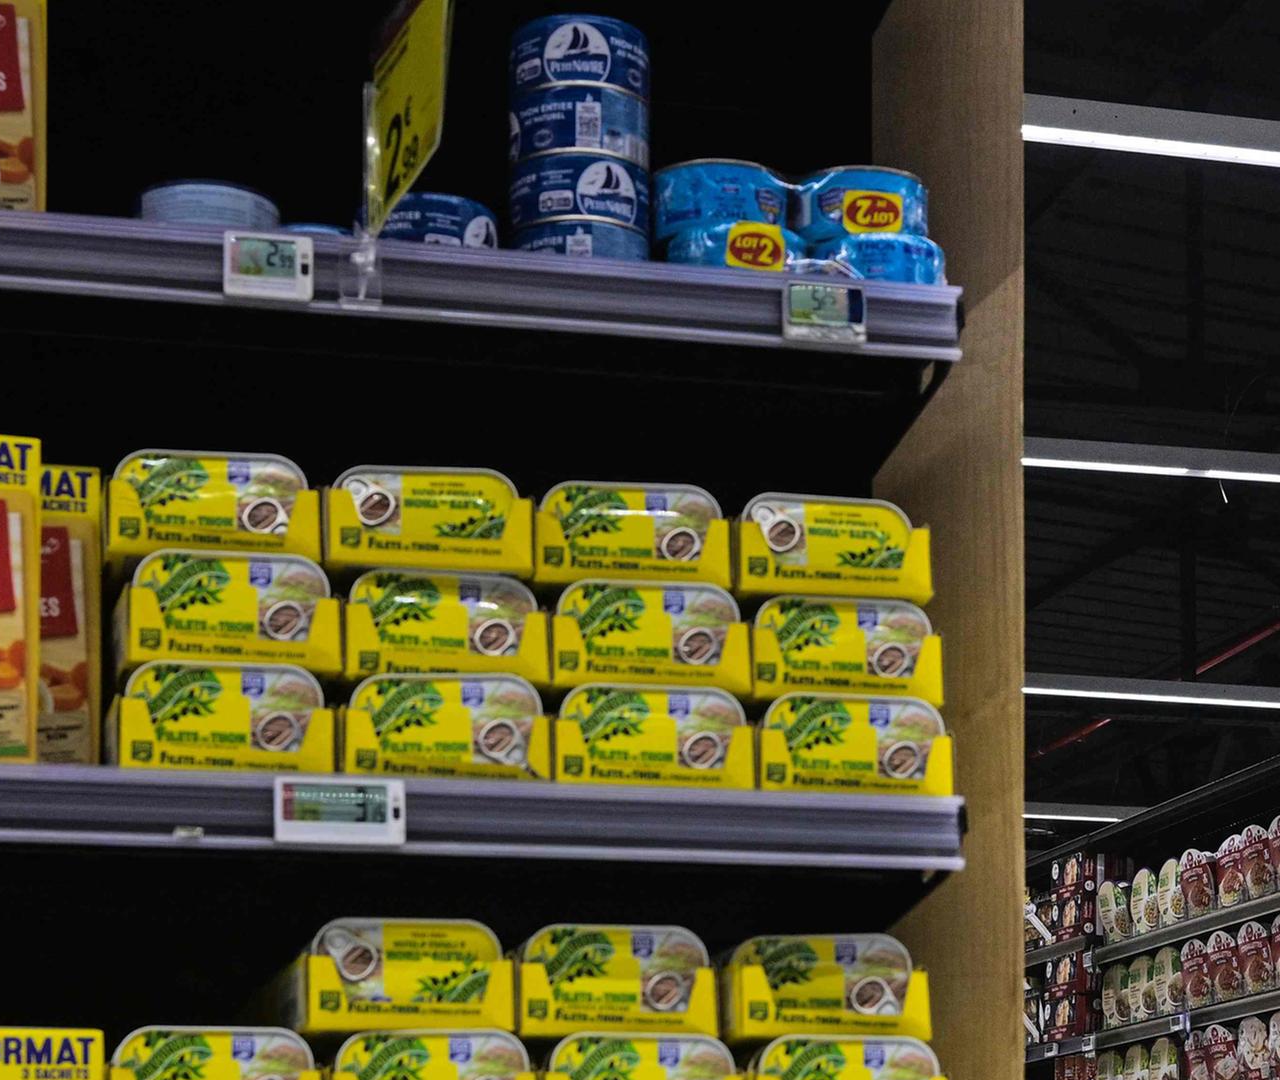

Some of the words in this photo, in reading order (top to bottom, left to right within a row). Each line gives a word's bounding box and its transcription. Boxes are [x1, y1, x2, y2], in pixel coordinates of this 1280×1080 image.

[855, 199, 871, 225] 2
[870, 211, 895, 224] LOT
[735, 236, 759, 249] LOT
[758, 237, 775, 266] 2
